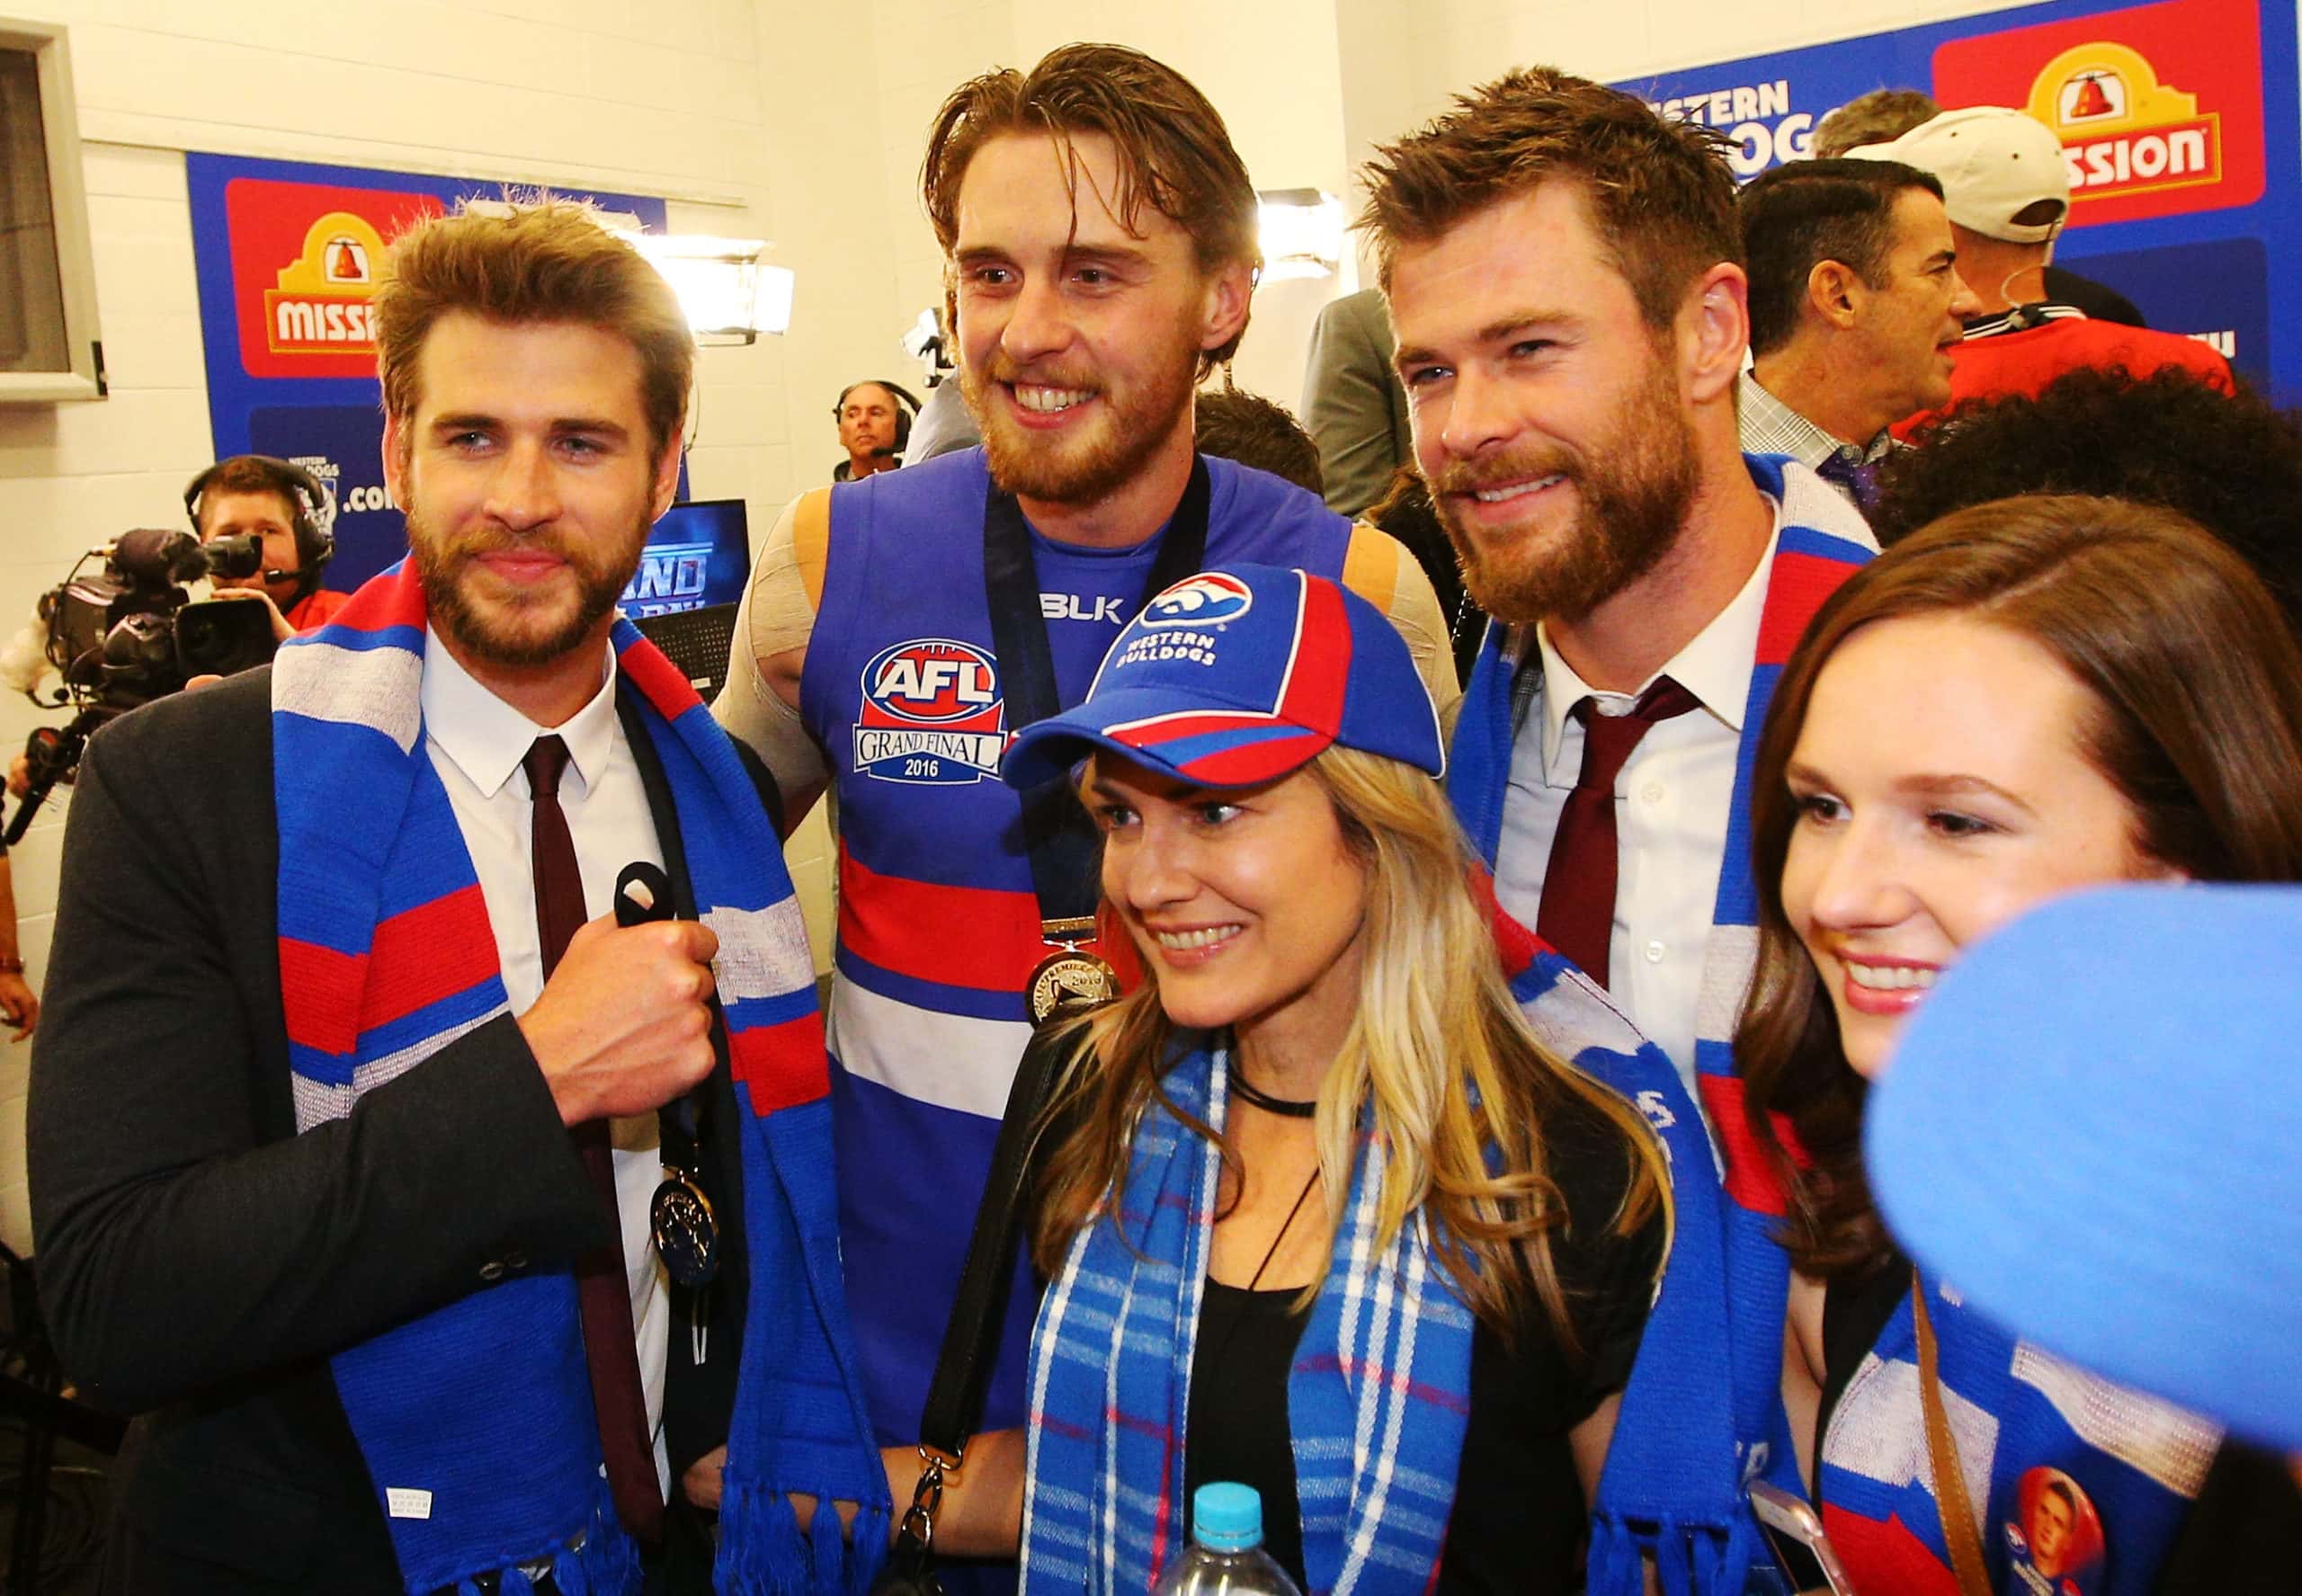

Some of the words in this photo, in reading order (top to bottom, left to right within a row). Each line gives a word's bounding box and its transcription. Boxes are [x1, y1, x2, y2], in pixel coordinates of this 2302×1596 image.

[1647, 80, 1789, 127] STERN
[1039, 593, 1124, 625] BLK
[1115, 646, 1217, 668] BULLDOGS
[1128, 631, 1216, 652] WESTERN
[872, 658, 994, 703] AFL
[860, 732, 923, 762] GRAND
[927, 733, 997, 769] FINAL
[905, 759, 939, 778] 2016
